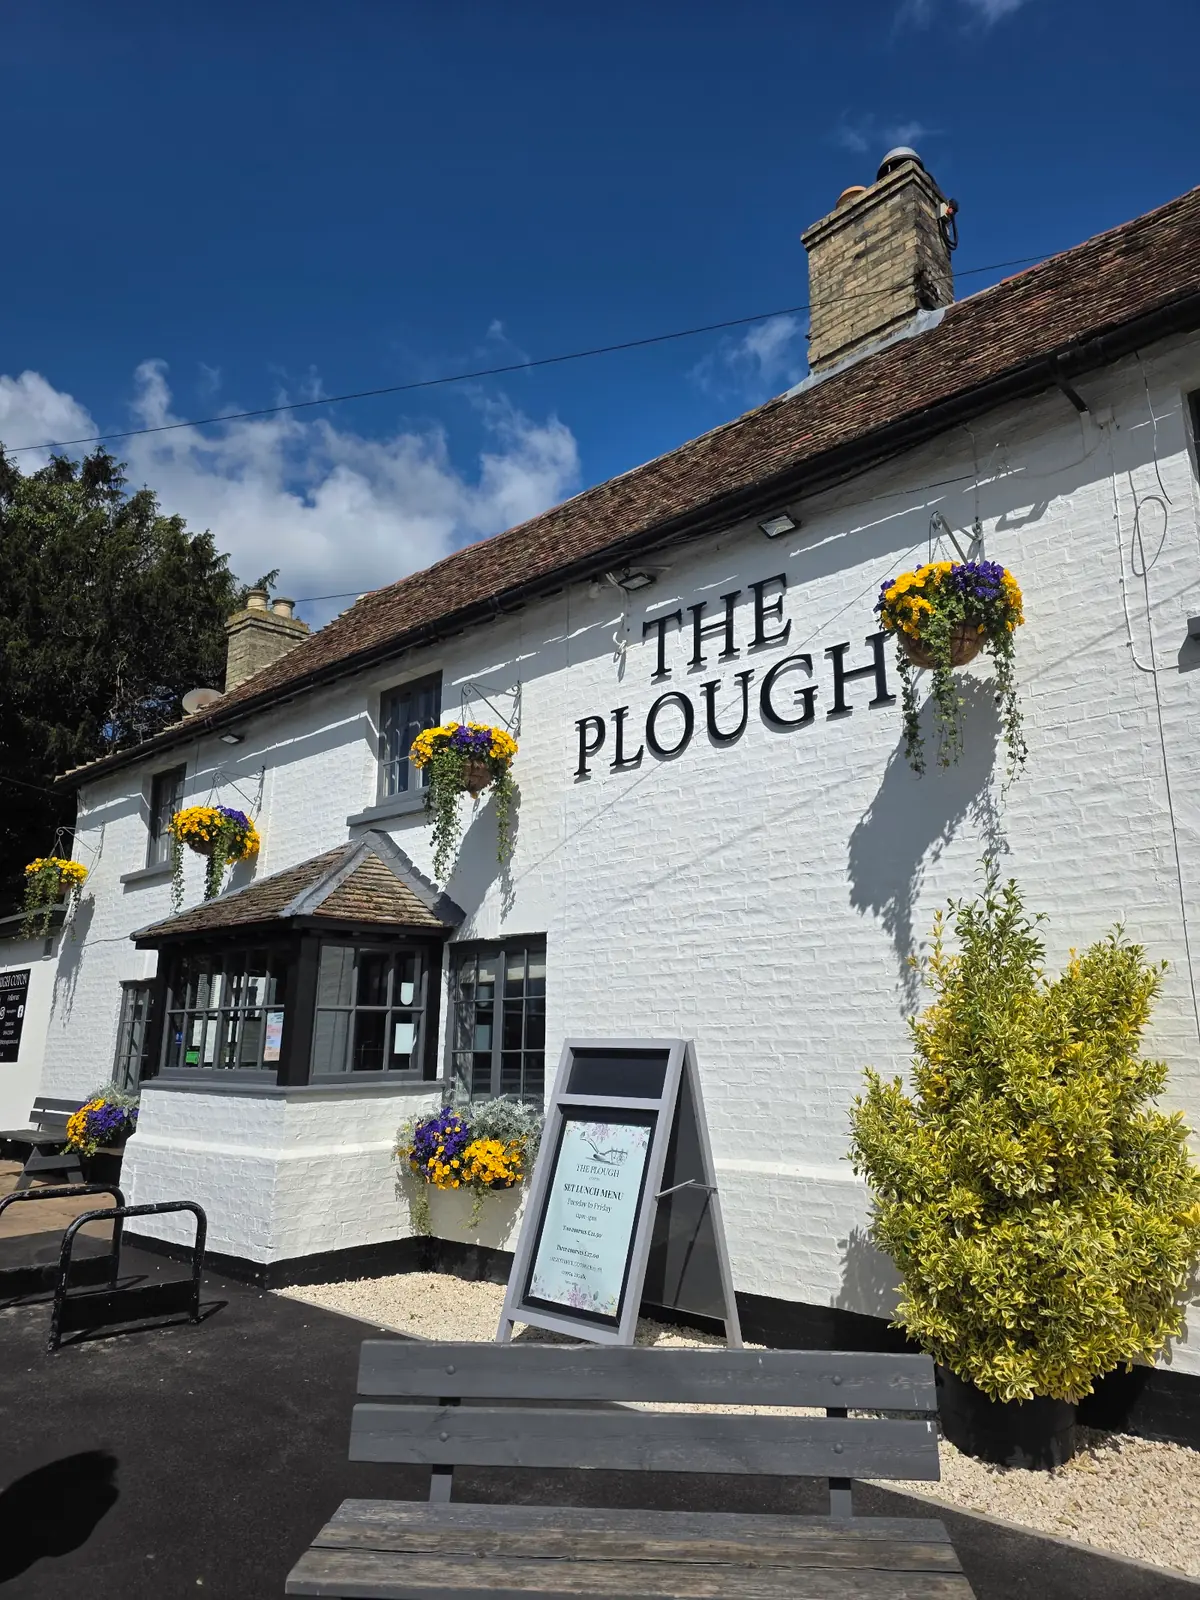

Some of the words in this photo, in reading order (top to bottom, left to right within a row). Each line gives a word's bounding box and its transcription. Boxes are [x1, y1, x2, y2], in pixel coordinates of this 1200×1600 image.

[642, 572, 791, 677] THE
[574, 630, 897, 776] PLOUGH
[576, 1164, 590, 1173] THE
[590, 1166, 620, 1178] PLOUGH
[564, 1183, 576, 1193] SET
[576, 1185, 600, 1197] LUNCH
[600, 1189, 624, 1201] MENU
[567, 1197, 587, 1208] Tuesday
[587, 1201, 594, 1209] to
[593, 1202, 612, 1213] Friday
